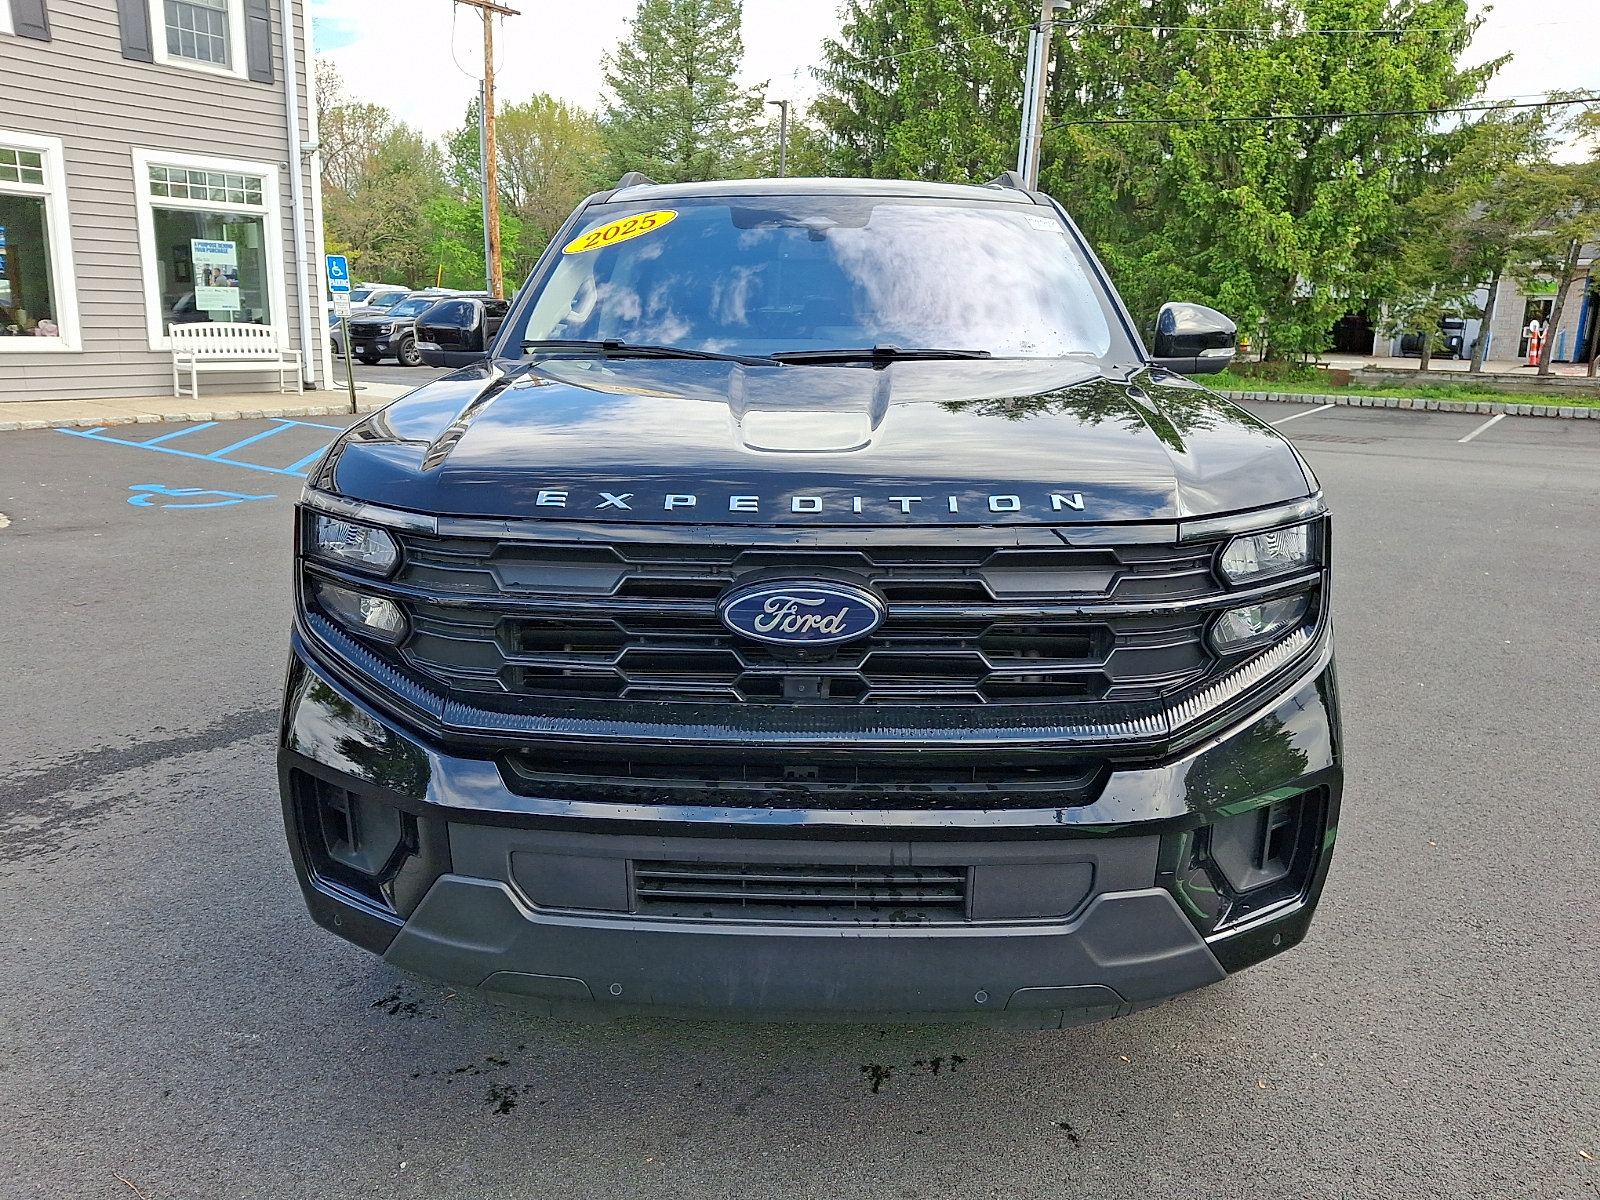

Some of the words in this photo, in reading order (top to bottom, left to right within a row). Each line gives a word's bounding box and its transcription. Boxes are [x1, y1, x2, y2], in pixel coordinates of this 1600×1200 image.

[583, 213, 657, 249] 2025
[535, 489, 1085, 515] EXPEDITION
[754, 595, 850, 634] Ford
